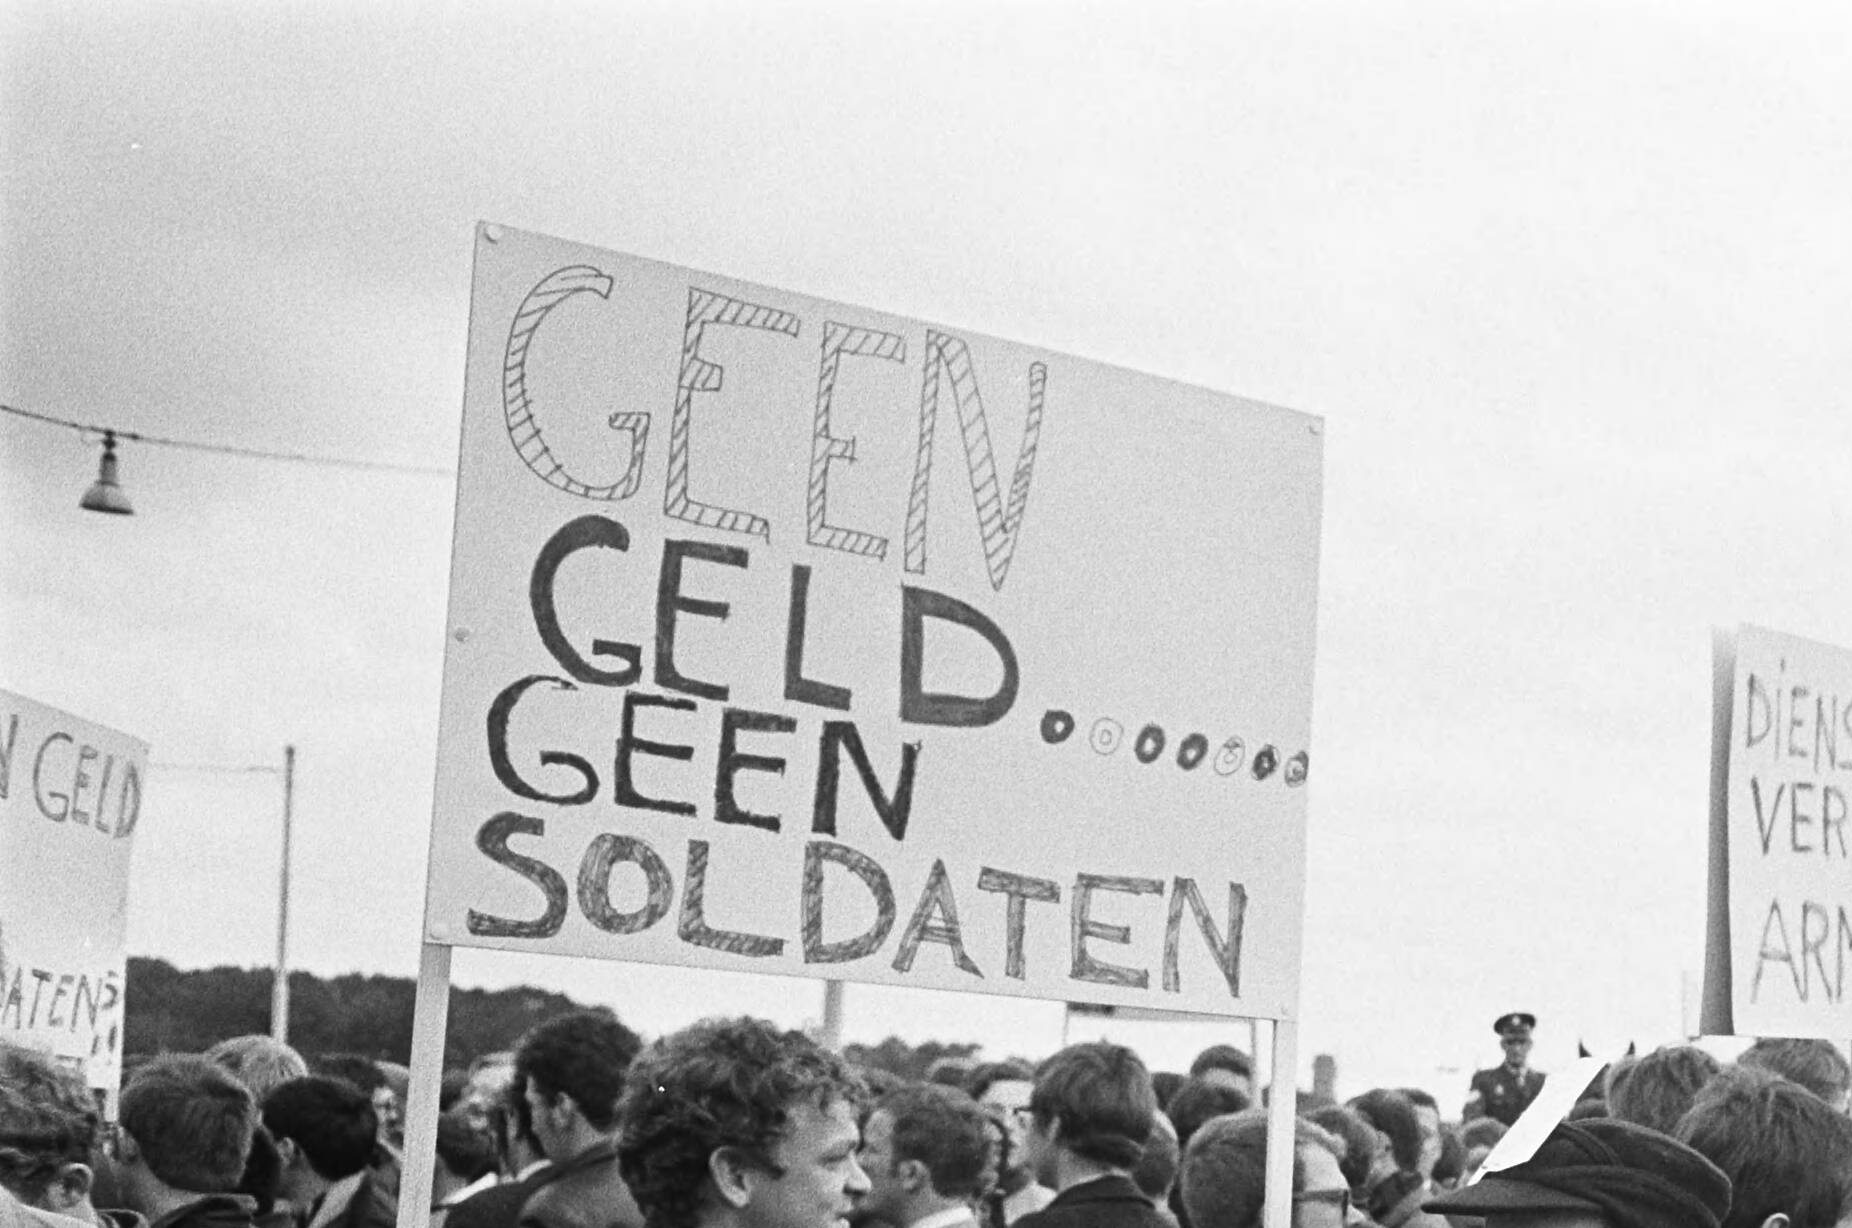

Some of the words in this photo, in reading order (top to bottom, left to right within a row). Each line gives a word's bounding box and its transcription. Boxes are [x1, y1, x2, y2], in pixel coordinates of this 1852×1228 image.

[502, 264, 1048, 591] GEEN
[32, 731, 142, 840] GELD
[486, 674, 922, 841] GEEN
[466, 811, 1249, 999] SOLDATEN
